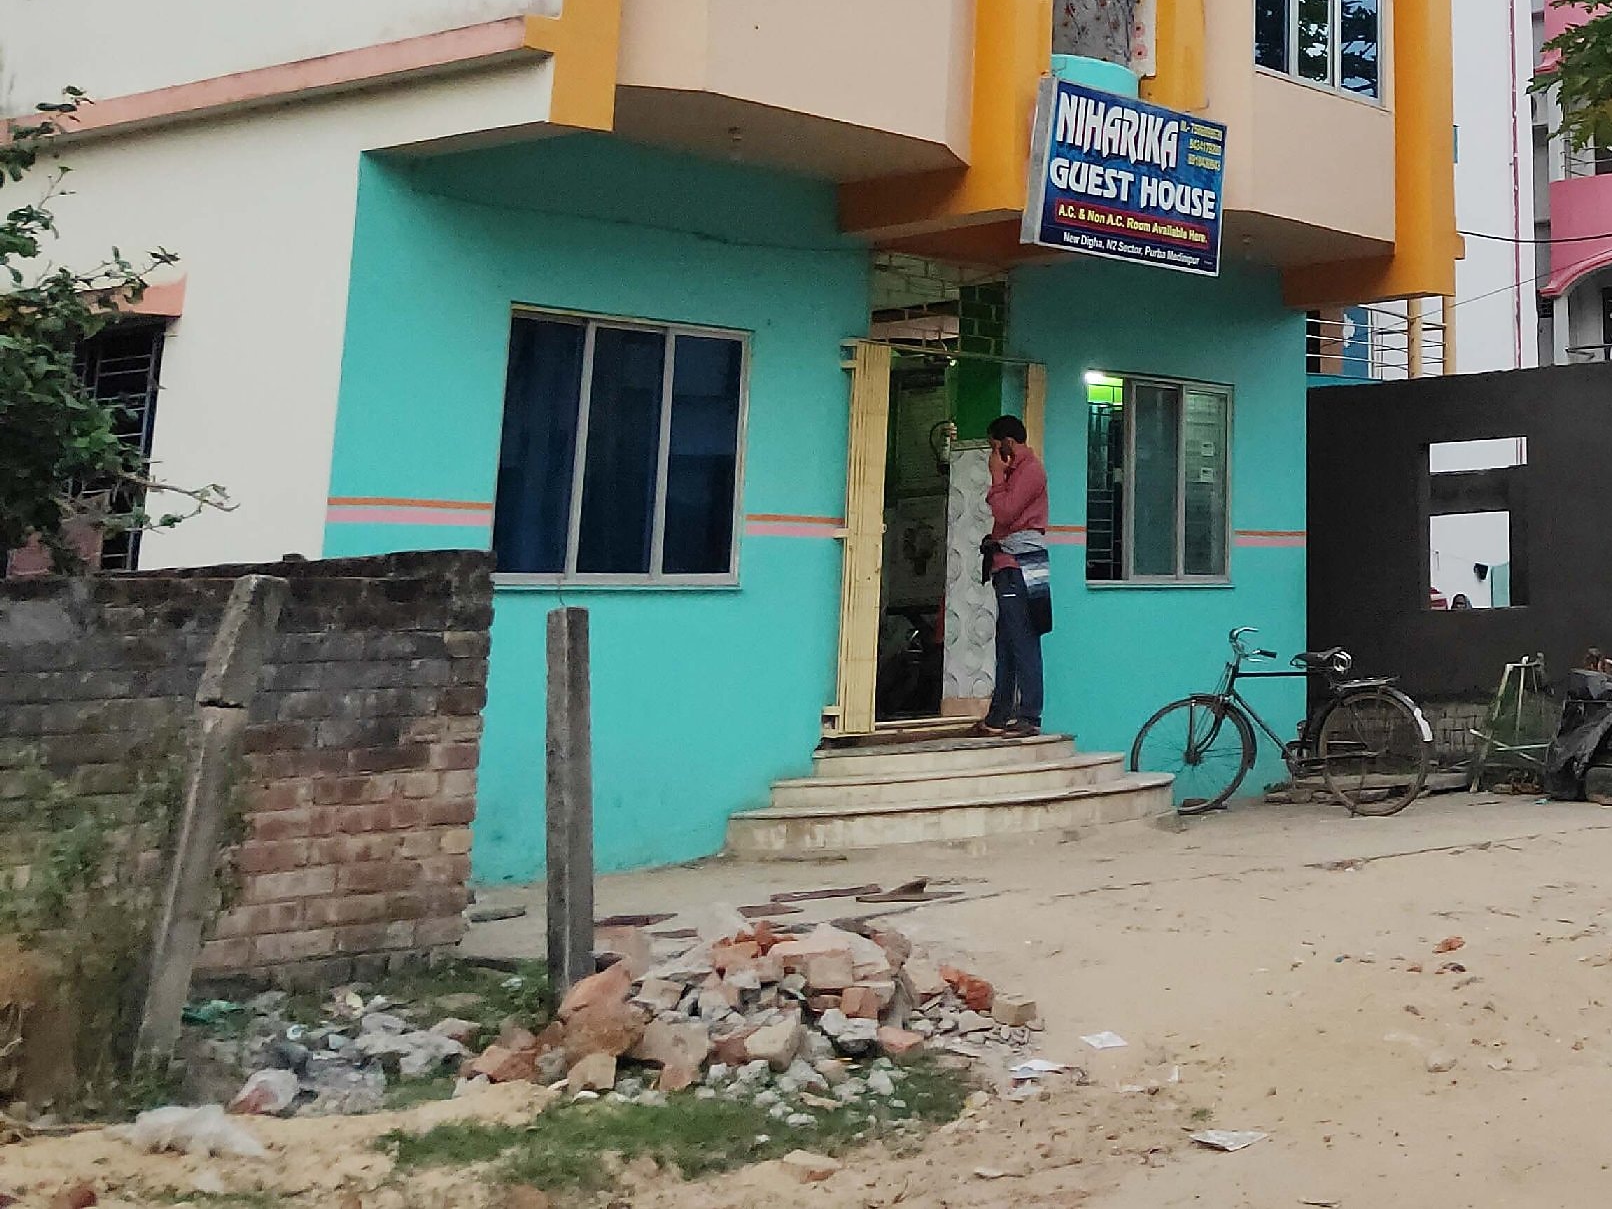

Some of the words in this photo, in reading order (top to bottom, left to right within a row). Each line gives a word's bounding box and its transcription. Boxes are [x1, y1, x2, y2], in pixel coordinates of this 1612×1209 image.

[1056, 91, 1179, 171] NIHARIKA
[1050, 157, 1134, 202] GUEST
[1140, 175, 1216, 220] HOUSE
[1059, 204, 1076, 218] A.C.
[1078, 209, 1086, 219] &
[1087, 210, 1105, 224] Non
[1106, 214, 1124, 227] A.C.
[1127, 217, 1151, 232] Room
[1152, 223, 1187, 239] Available
[1064, 232, 1080, 243] New
